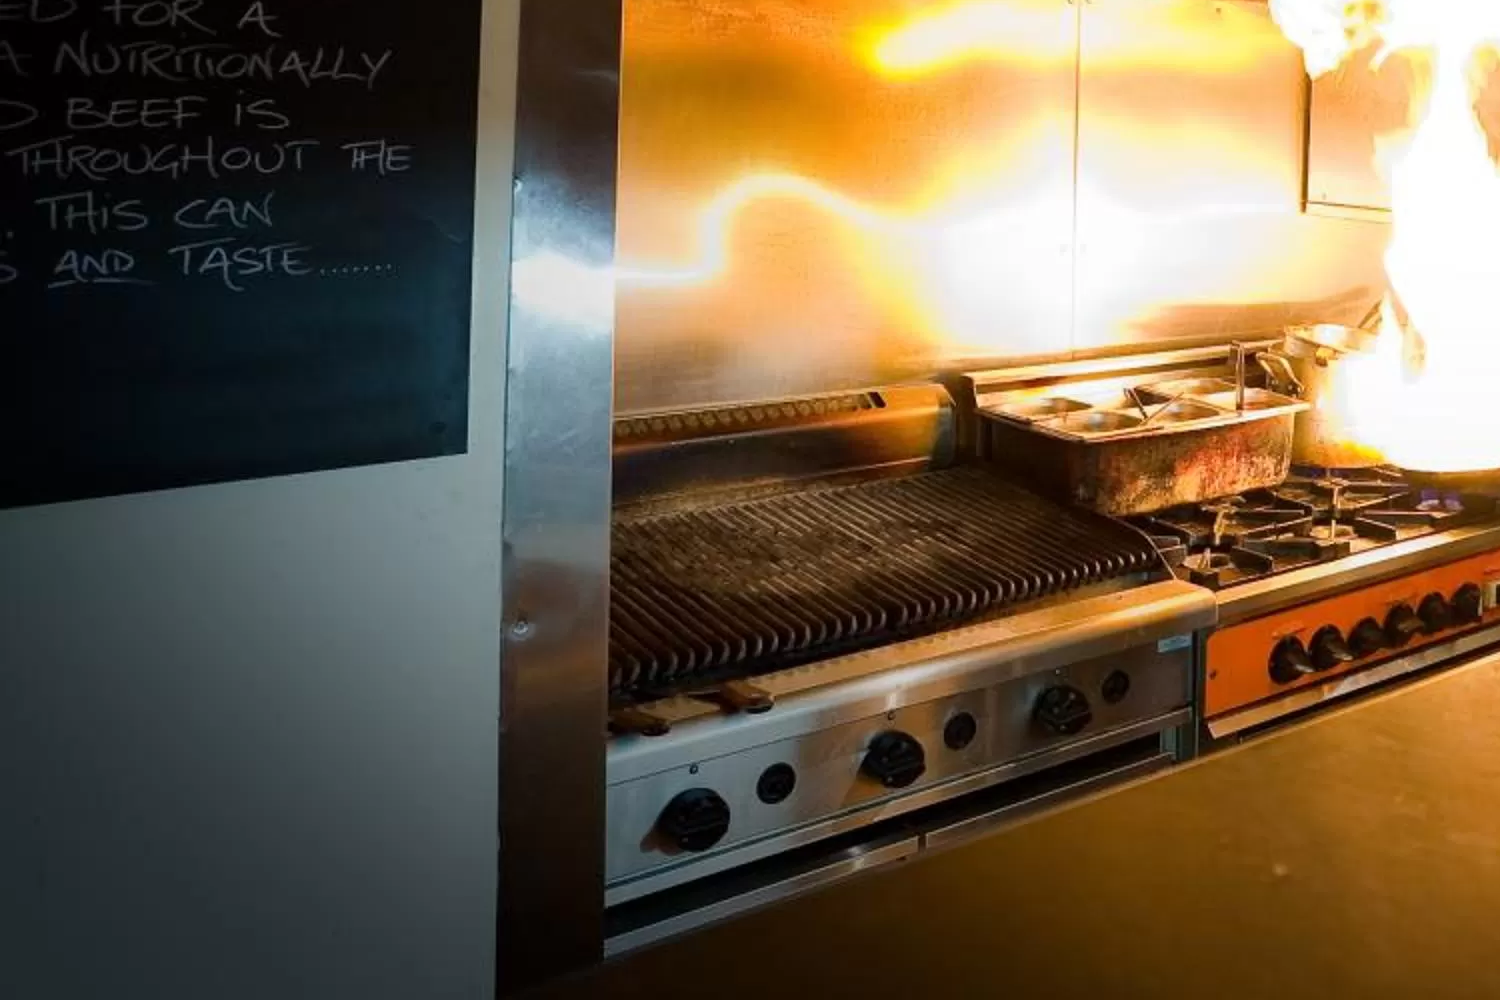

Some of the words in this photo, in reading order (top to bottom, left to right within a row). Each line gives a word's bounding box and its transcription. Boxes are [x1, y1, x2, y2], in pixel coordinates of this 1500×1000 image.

[236, 0, 282, 38] A
[66, 94, 208, 130] BEEF
[6, 134, 320, 181] THROUGHOUT
[341, 140, 415, 176] THE
[174, 190, 275, 228] CAN
[48, 249, 156, 288] AND
